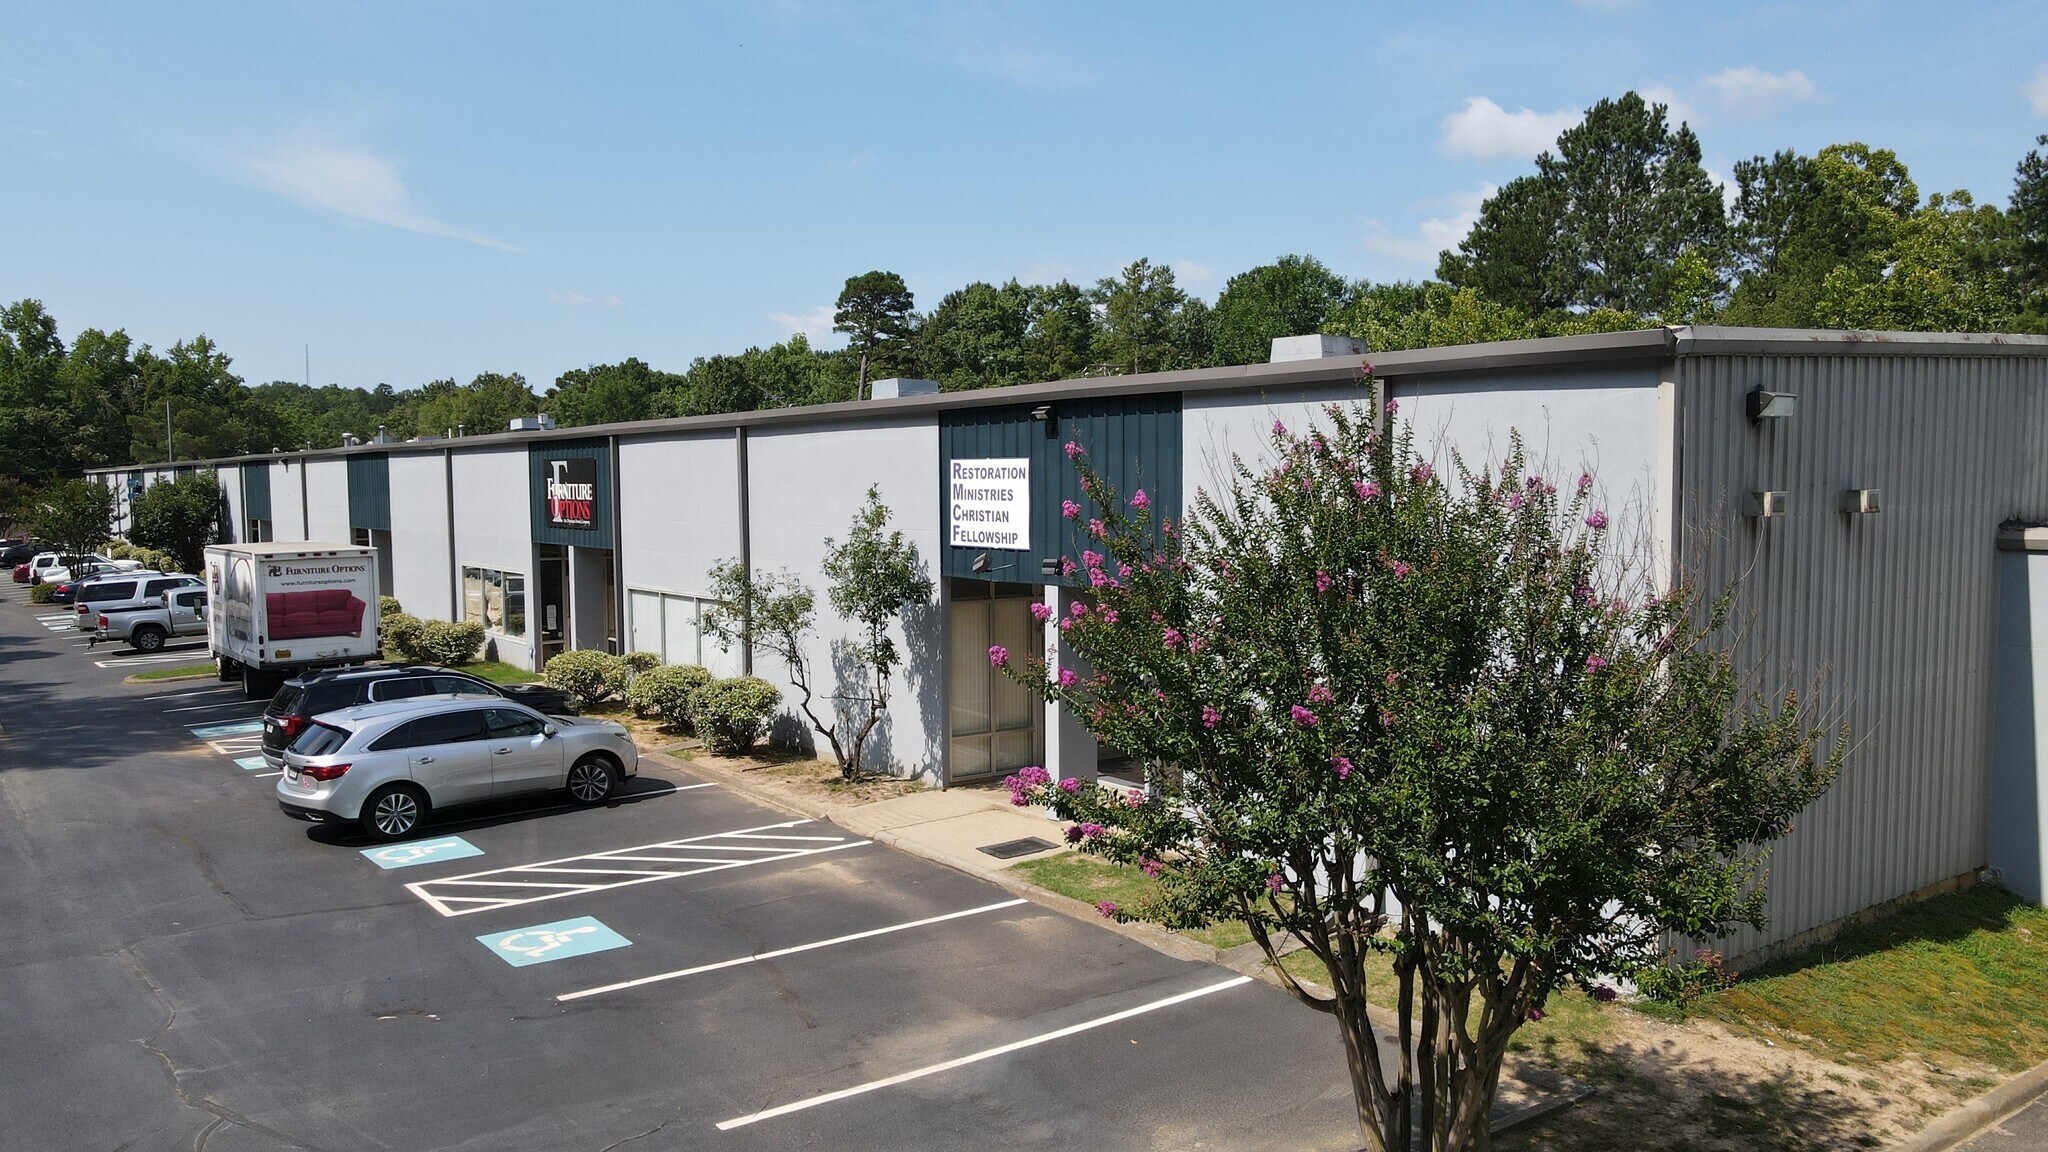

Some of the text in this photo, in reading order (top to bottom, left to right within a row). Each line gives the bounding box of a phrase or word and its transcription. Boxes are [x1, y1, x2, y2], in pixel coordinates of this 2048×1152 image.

[953, 462, 1026, 480] RESTORATION
[547, 478, 593, 501] FURNITURE
[953, 483, 1014, 501] MINISTRIES
[550, 495, 591, 520] OPTIONS
[953, 504, 1009, 522] CHRISTIAN
[953, 524, 1018, 544] FELLOWSHIP
[285, 564, 366, 576] FURNITURE OPTIONS
[281, 578, 356, 586] www.furnitureoptions.com
